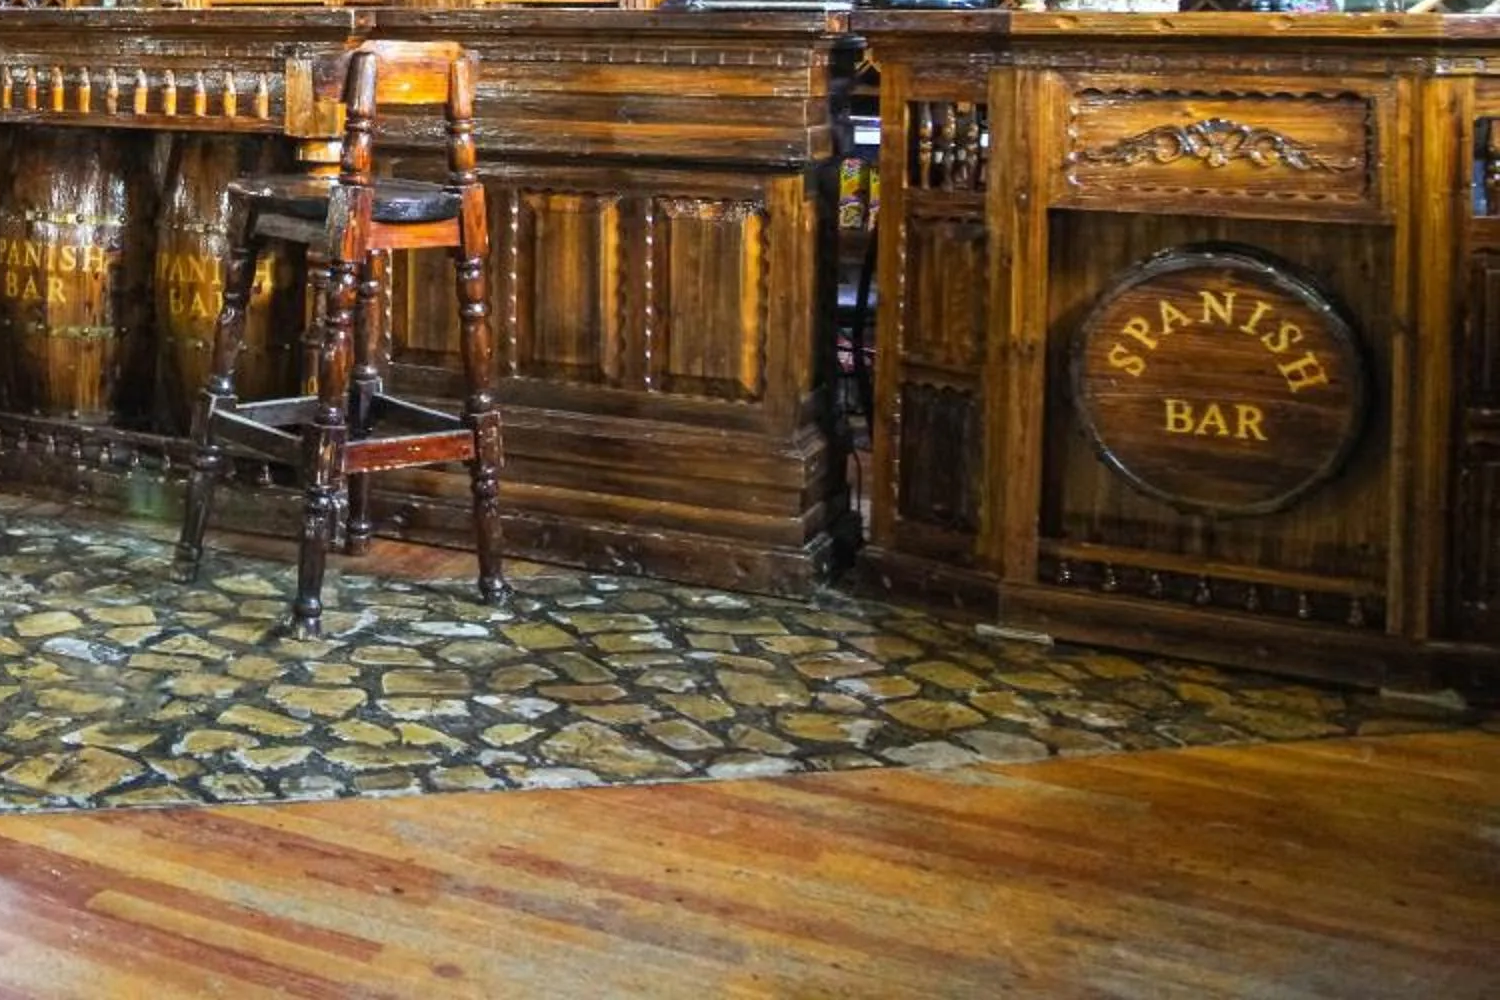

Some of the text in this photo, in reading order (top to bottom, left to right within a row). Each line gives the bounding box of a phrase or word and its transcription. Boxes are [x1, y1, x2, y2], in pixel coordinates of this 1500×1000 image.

[4, 271, 68, 305] BAR
[1107, 290, 1329, 394] SPANISH
[1163, 399, 1269, 441] BAR
